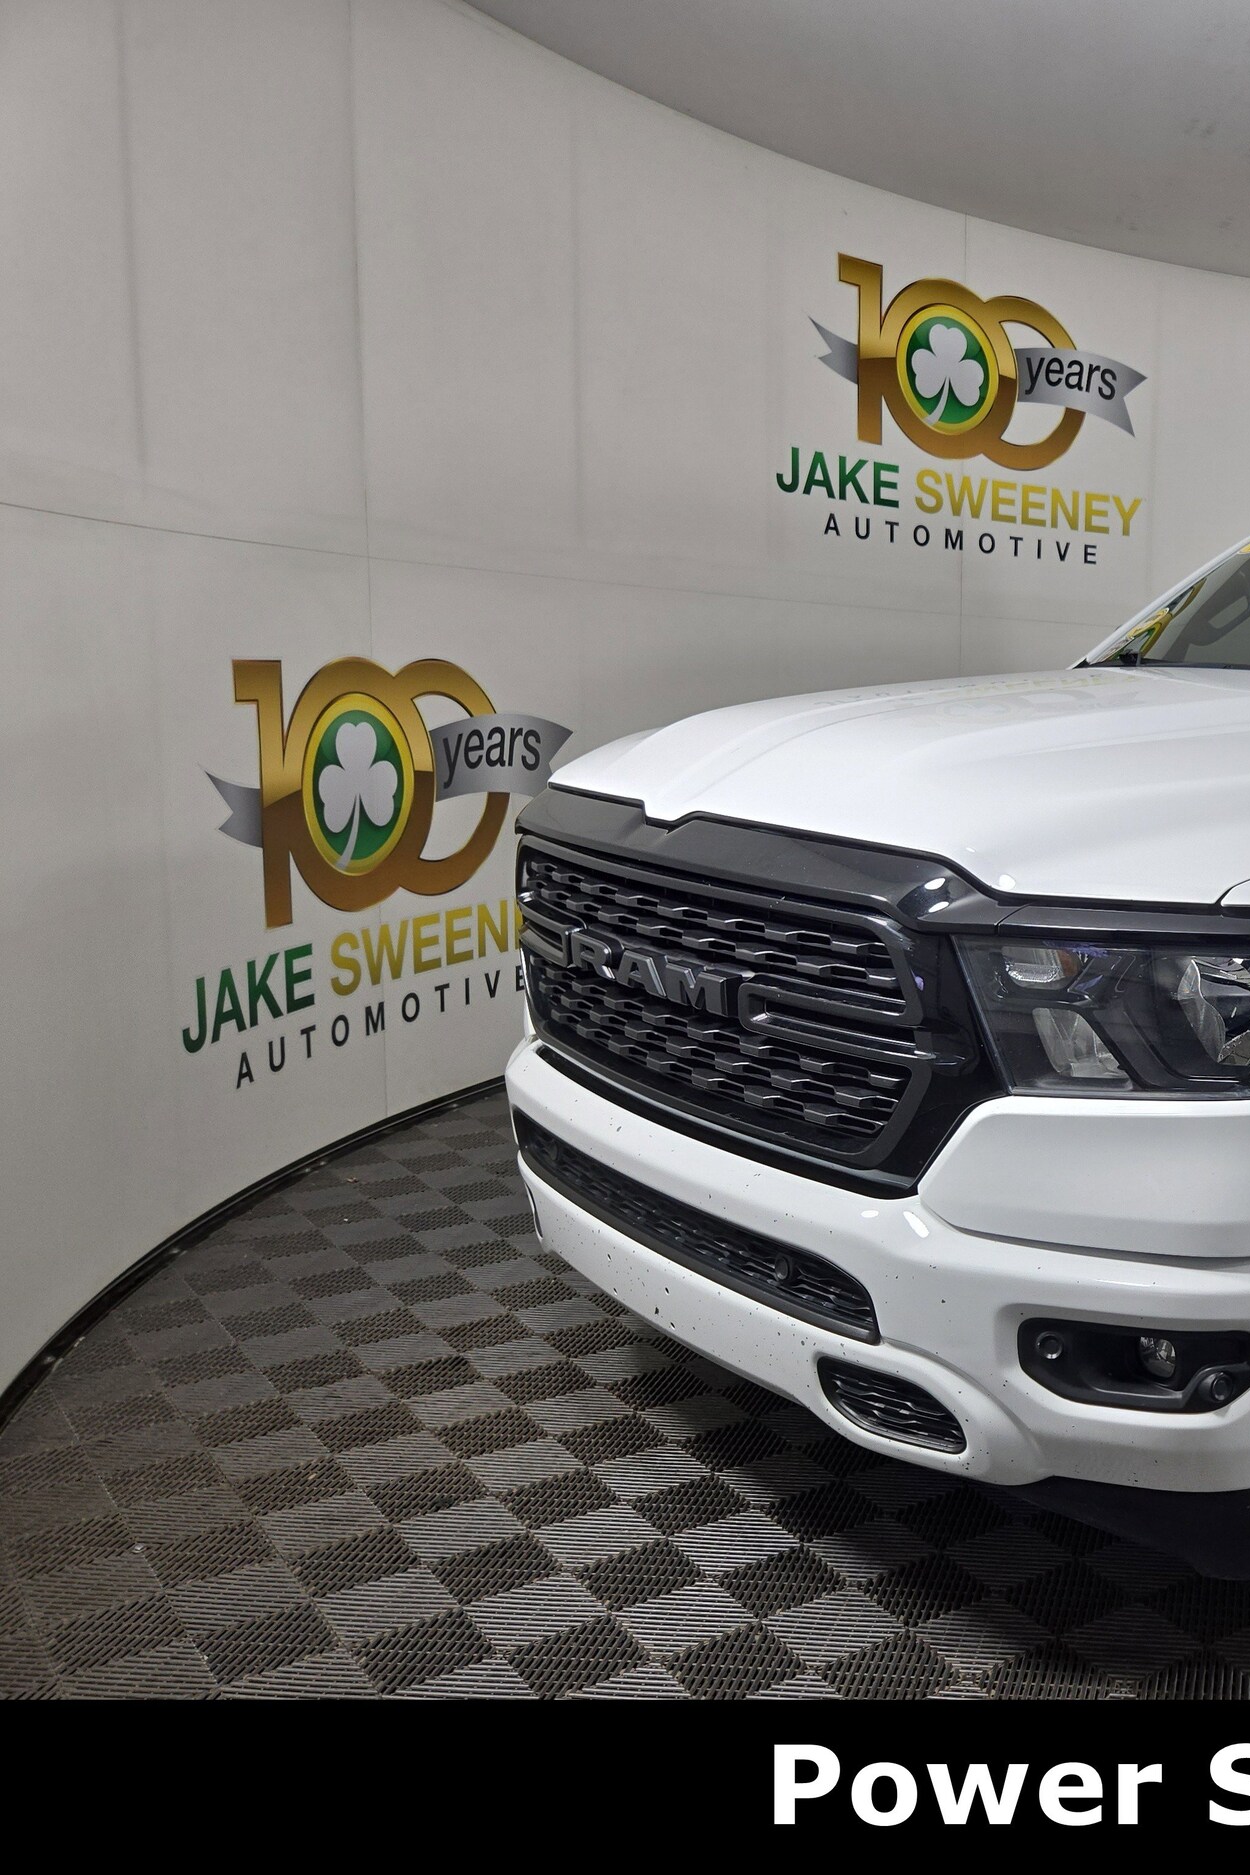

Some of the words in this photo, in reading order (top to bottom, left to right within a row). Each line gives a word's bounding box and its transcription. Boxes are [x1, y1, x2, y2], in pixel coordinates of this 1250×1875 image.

[837, 252, 1088, 471] 100
[1024, 355, 1118, 401] years
[776, 446, 900, 509] JAKE
[914, 469, 1142, 537] SWEENEY
[823, 513, 1098, 566] AUTOMOTIVE
[231, 656, 511, 930] 100
[442, 726, 542, 790] years
[181, 943, 316, 1054] JAKE
[235, 965, 526, 1090] AUTOMOTIVE
[571, 928, 743, 1017] RAM
